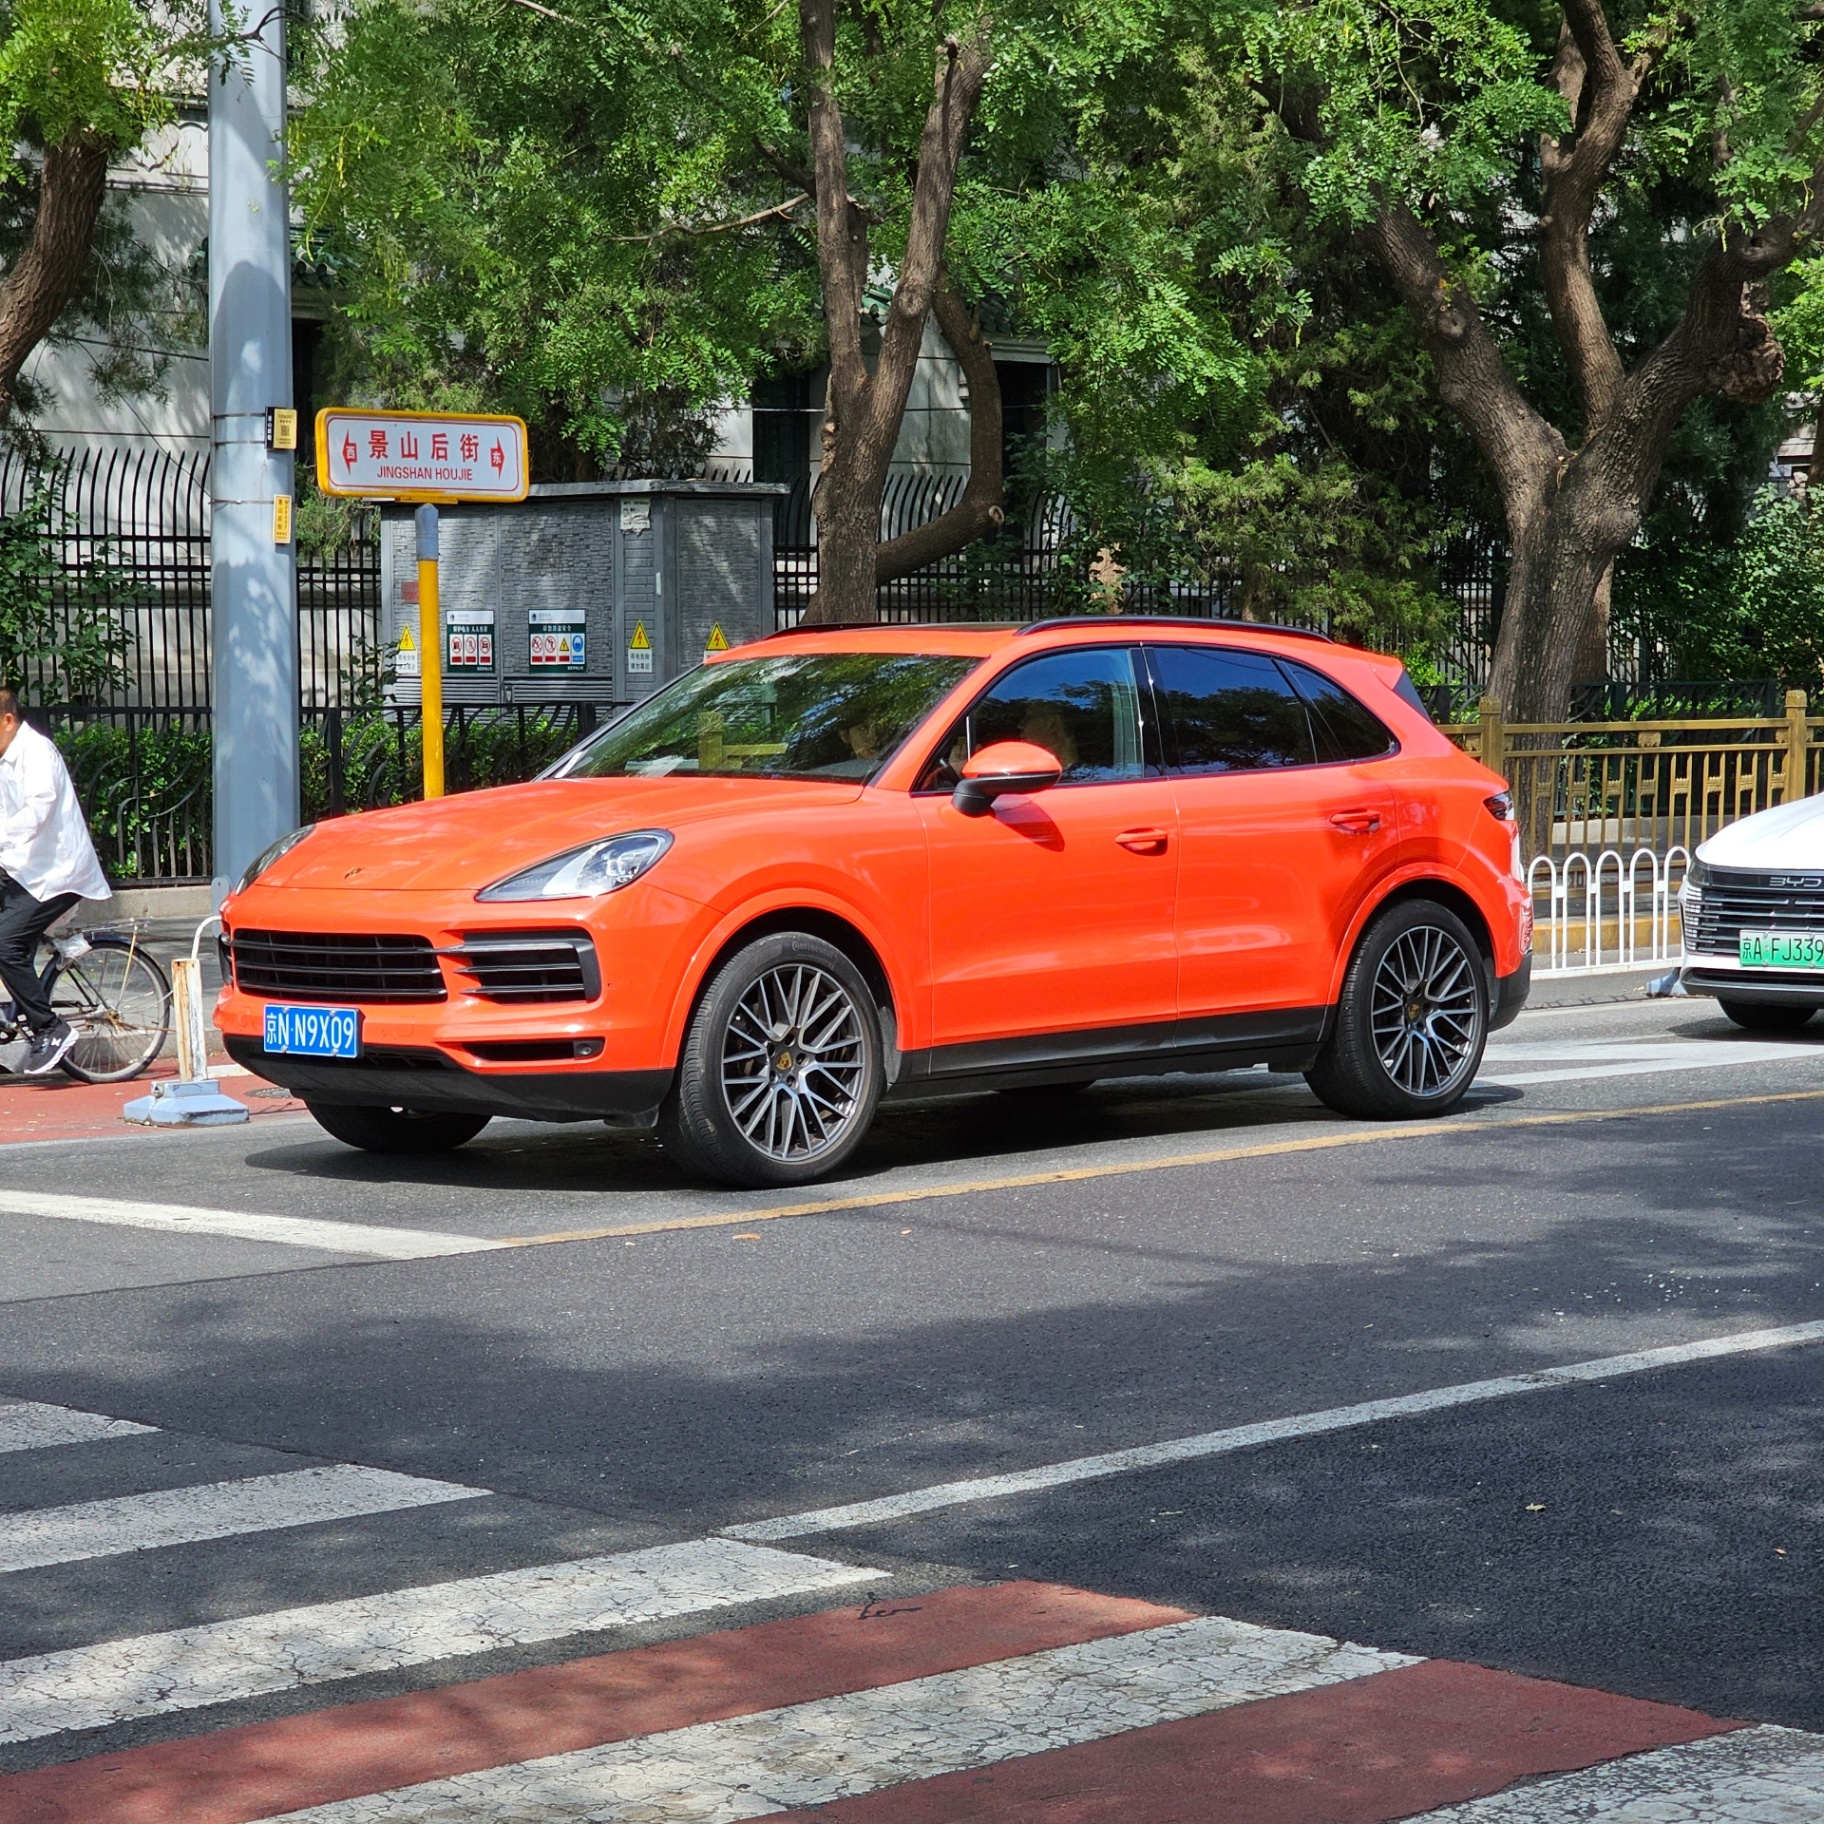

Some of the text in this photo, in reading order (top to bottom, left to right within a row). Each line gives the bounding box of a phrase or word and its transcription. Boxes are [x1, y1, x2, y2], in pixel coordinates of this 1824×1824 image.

[346, 445, 356, 459] 西
[368, 430, 480, 463] 景山后街
[491, 450, 502, 465] 东
[377, 465, 473, 481] JINGSHAN HOUJIE
[1769, 876, 1822, 887] BYD
